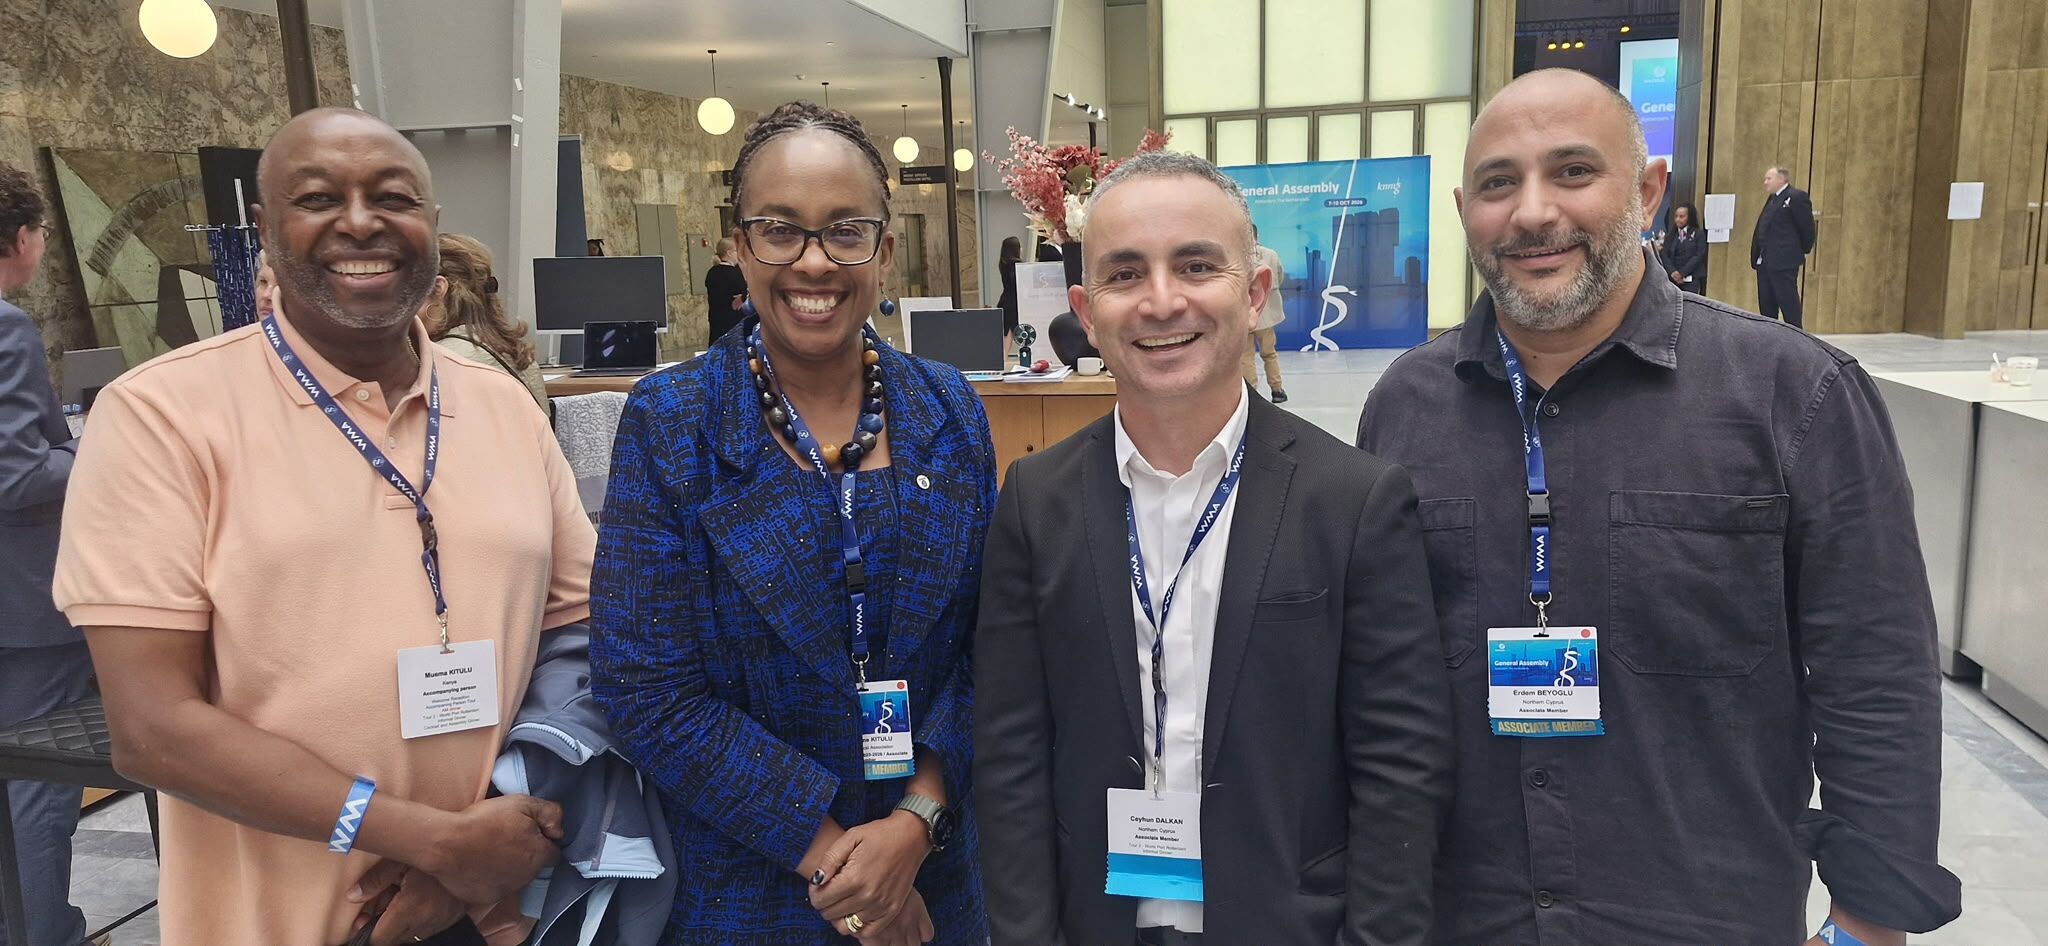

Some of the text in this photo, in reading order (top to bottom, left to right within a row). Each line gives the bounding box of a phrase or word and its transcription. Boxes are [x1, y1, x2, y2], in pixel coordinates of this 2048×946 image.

[1282, 181, 1340, 195] Assembly
[266, 323, 280, 349] WMA
[296, 369, 320, 398] WMA
[1513, 372, 1523, 403] WMA
[341, 421, 367, 451] WMA
[428, 435, 437, 461] WMA
[809, 447, 827, 479] WMA
[391, 473, 416, 502] WMA
[1199, 503, 1221, 533] WMA
[1536, 535, 1545, 572] WMA
[1130, 555, 1143, 589] WMA
[449, 667, 473, 675] KITULU
[1494, 659, 1549, 668] General Assembly
[423, 687, 459, 696] Accompanying
[1498, 721, 1596, 734] ASSOCIATE MEMBER
[872, 763, 908, 775] MEMBER
[1155, 817, 1183, 825] DALKAN
